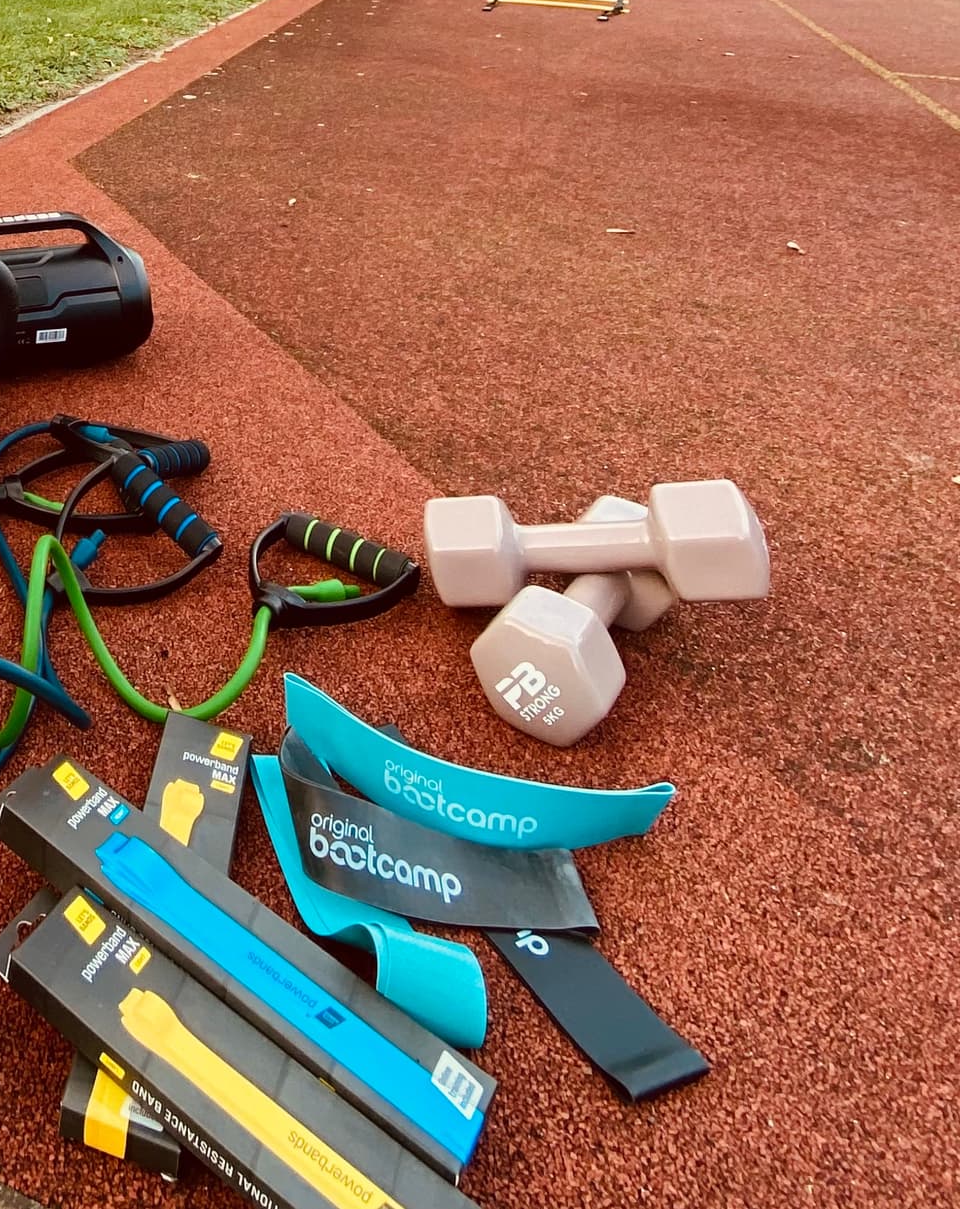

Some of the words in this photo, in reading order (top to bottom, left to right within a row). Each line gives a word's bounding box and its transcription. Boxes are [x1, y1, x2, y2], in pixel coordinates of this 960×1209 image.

[519, 684, 561, 722] STRONG
[542, 706, 565, 727] 5KG
[182, 750, 240, 776] powerband
[211, 769, 237, 786] MAX
[384, 759, 443, 793] original
[67, 785, 108, 830] powerband
[97, 796, 121, 818] MAX
[383, 767, 538, 840] bootcamp
[310, 813, 374, 844] original
[309, 826, 463, 903] bootcamp
[81, 925, 128, 983] powerband
[114, 936, 141, 965] MAX
[247, 950, 318, 1010] powerbands
[131, 1080, 162, 1113] BAND
[164, 1107, 234, 1178] RESISTANCE
[287, 1129, 375, 1204] powerbands
